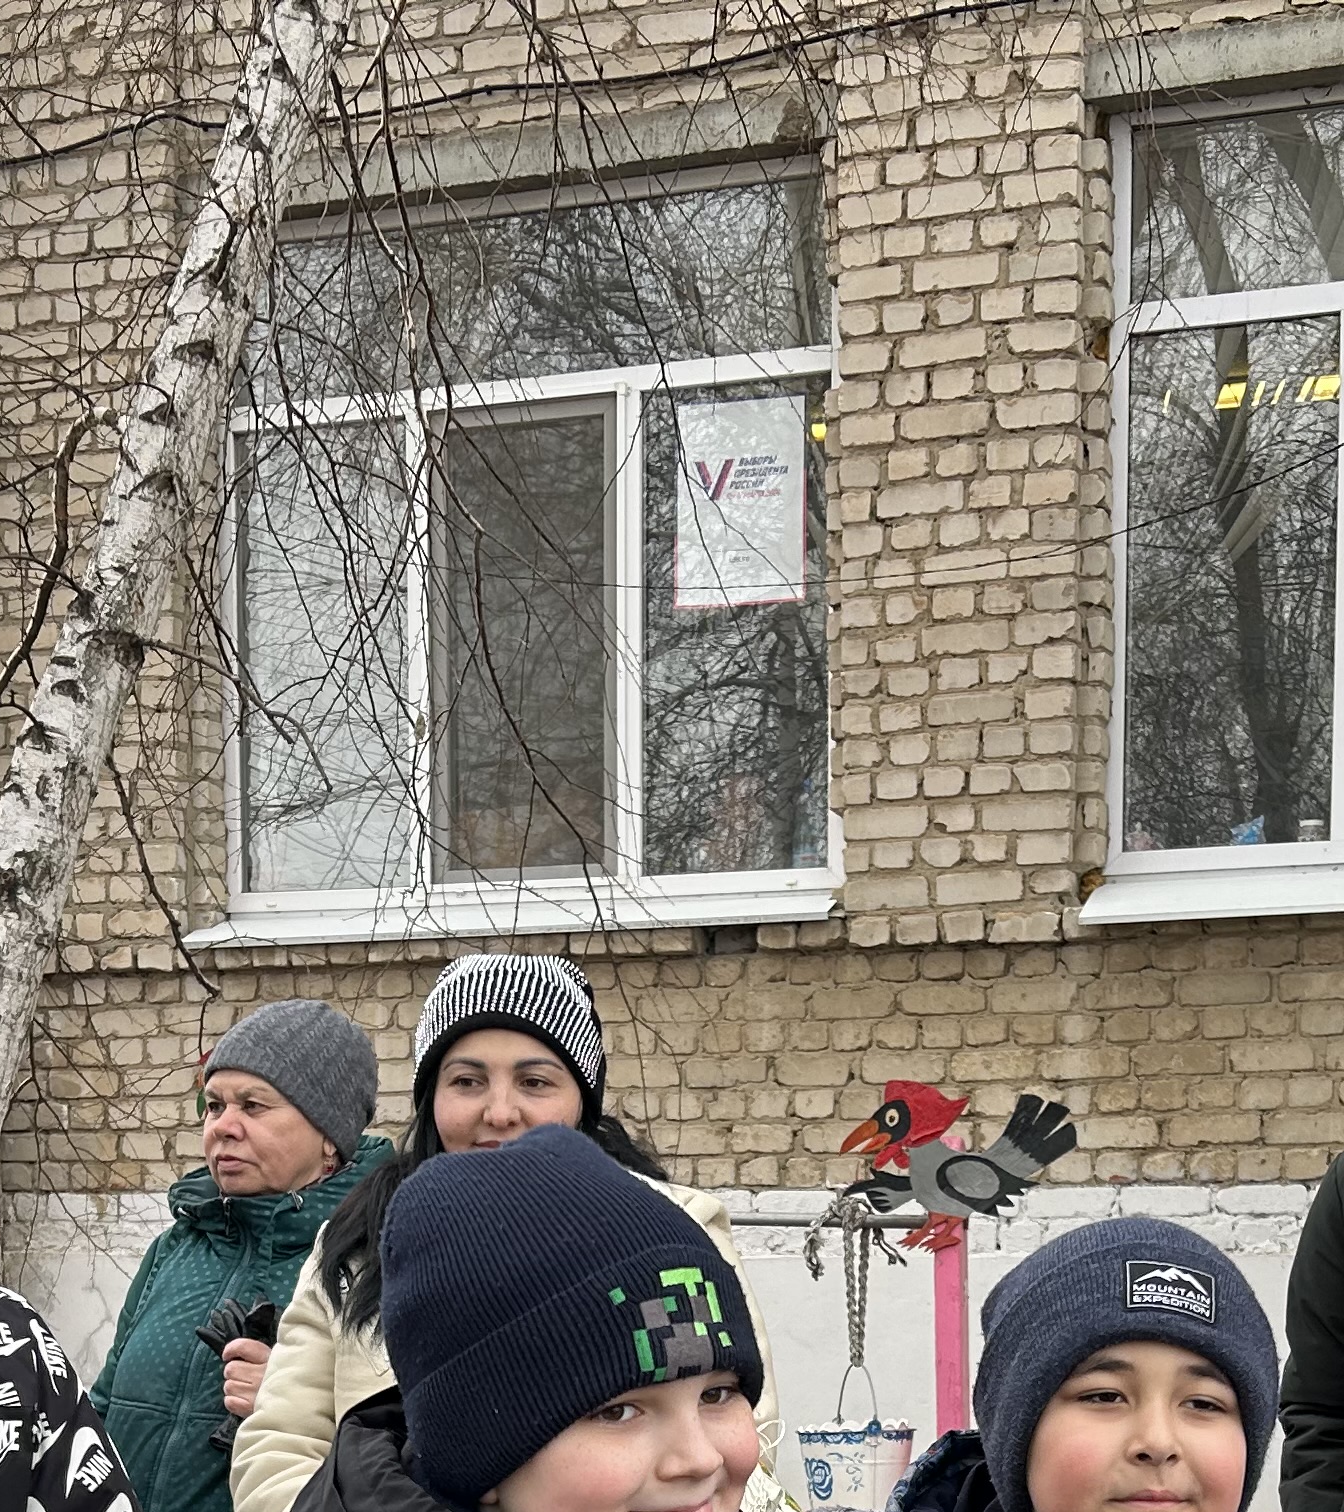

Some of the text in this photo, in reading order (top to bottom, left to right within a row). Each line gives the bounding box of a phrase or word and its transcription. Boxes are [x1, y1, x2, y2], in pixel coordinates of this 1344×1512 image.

[1133, 1283, 1210, 1305] MOUNTAIN
[1133, 1295, 1210, 1317] EXPEDITION
[44, 1336, 68, 1380] NIKE
[75, 1449, 114, 1492] NIKE
